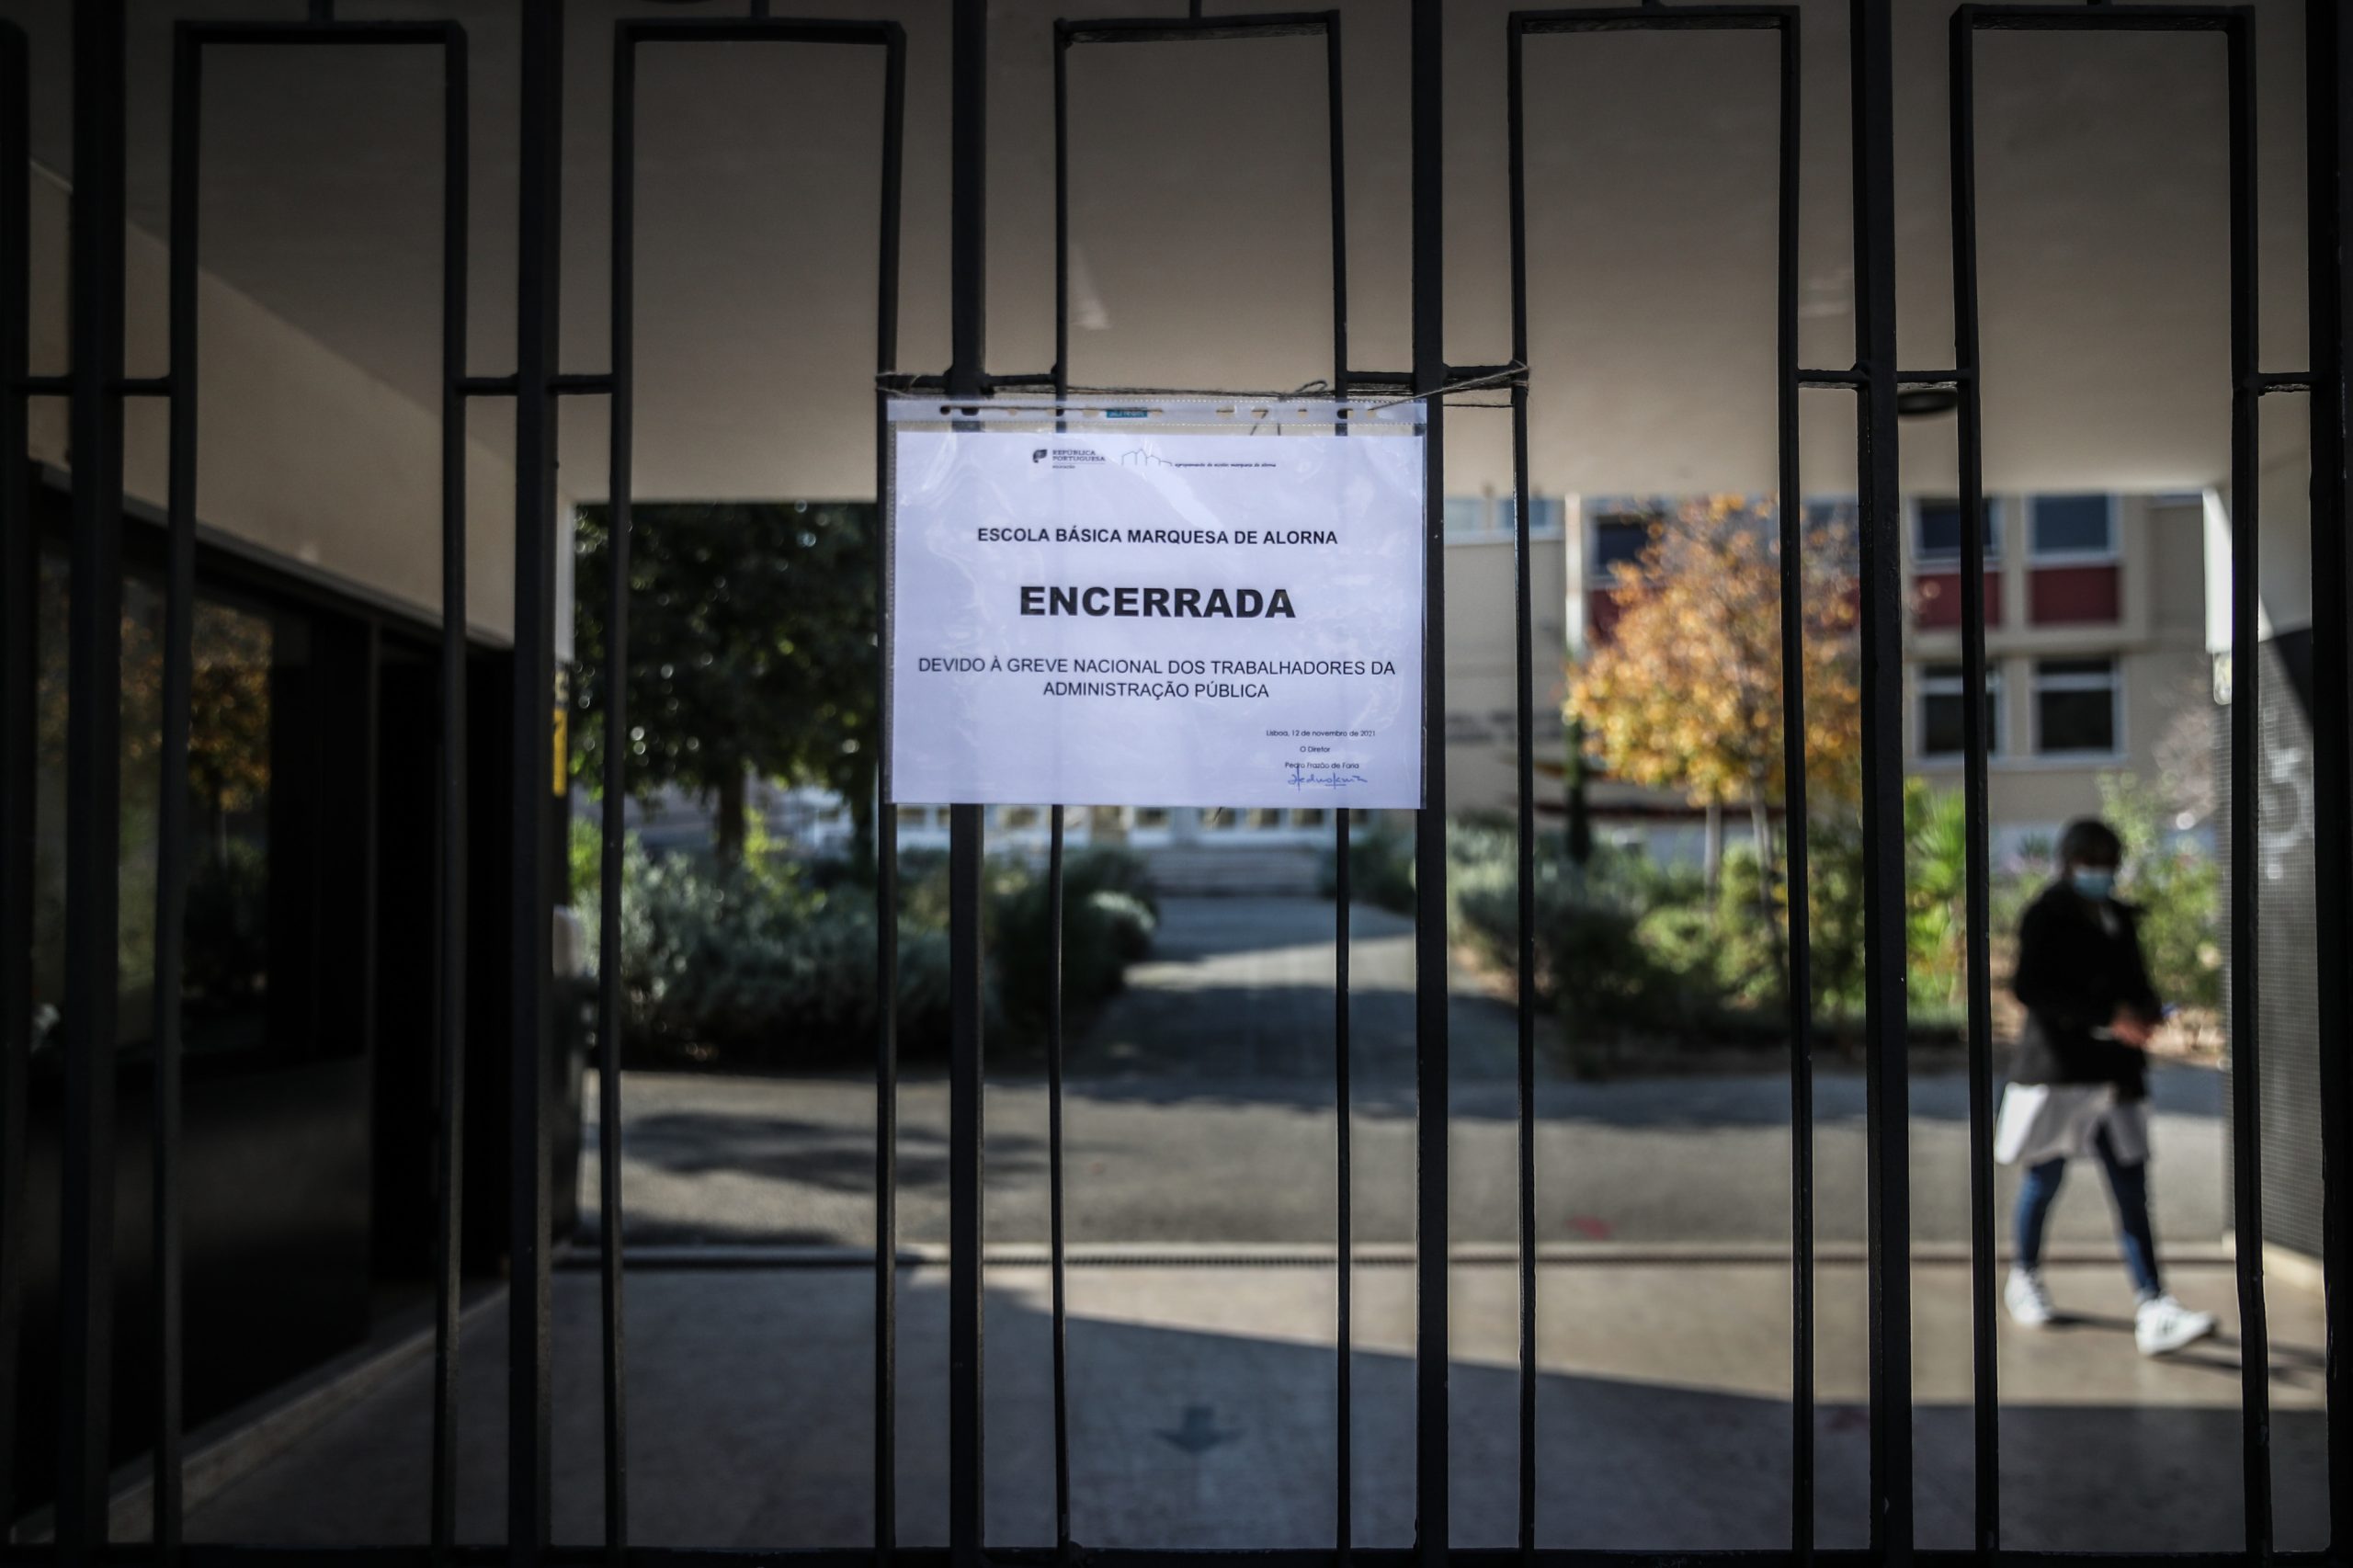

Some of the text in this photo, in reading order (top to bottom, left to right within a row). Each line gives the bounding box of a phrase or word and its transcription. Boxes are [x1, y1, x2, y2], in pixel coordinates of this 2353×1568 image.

[977, 525, 1338, 545] ESCOLA BÁSICA MARQUESA DE ALORNA
[1019, 585, 1297, 619] ENCERRADA
[918, 654, 1396, 676] DEVIDO À GREVE NACIONAL DOS TRABALHADORES DA
[1042, 680, 1269, 701] ADMINISTRAÇÃO PÚBLICA
